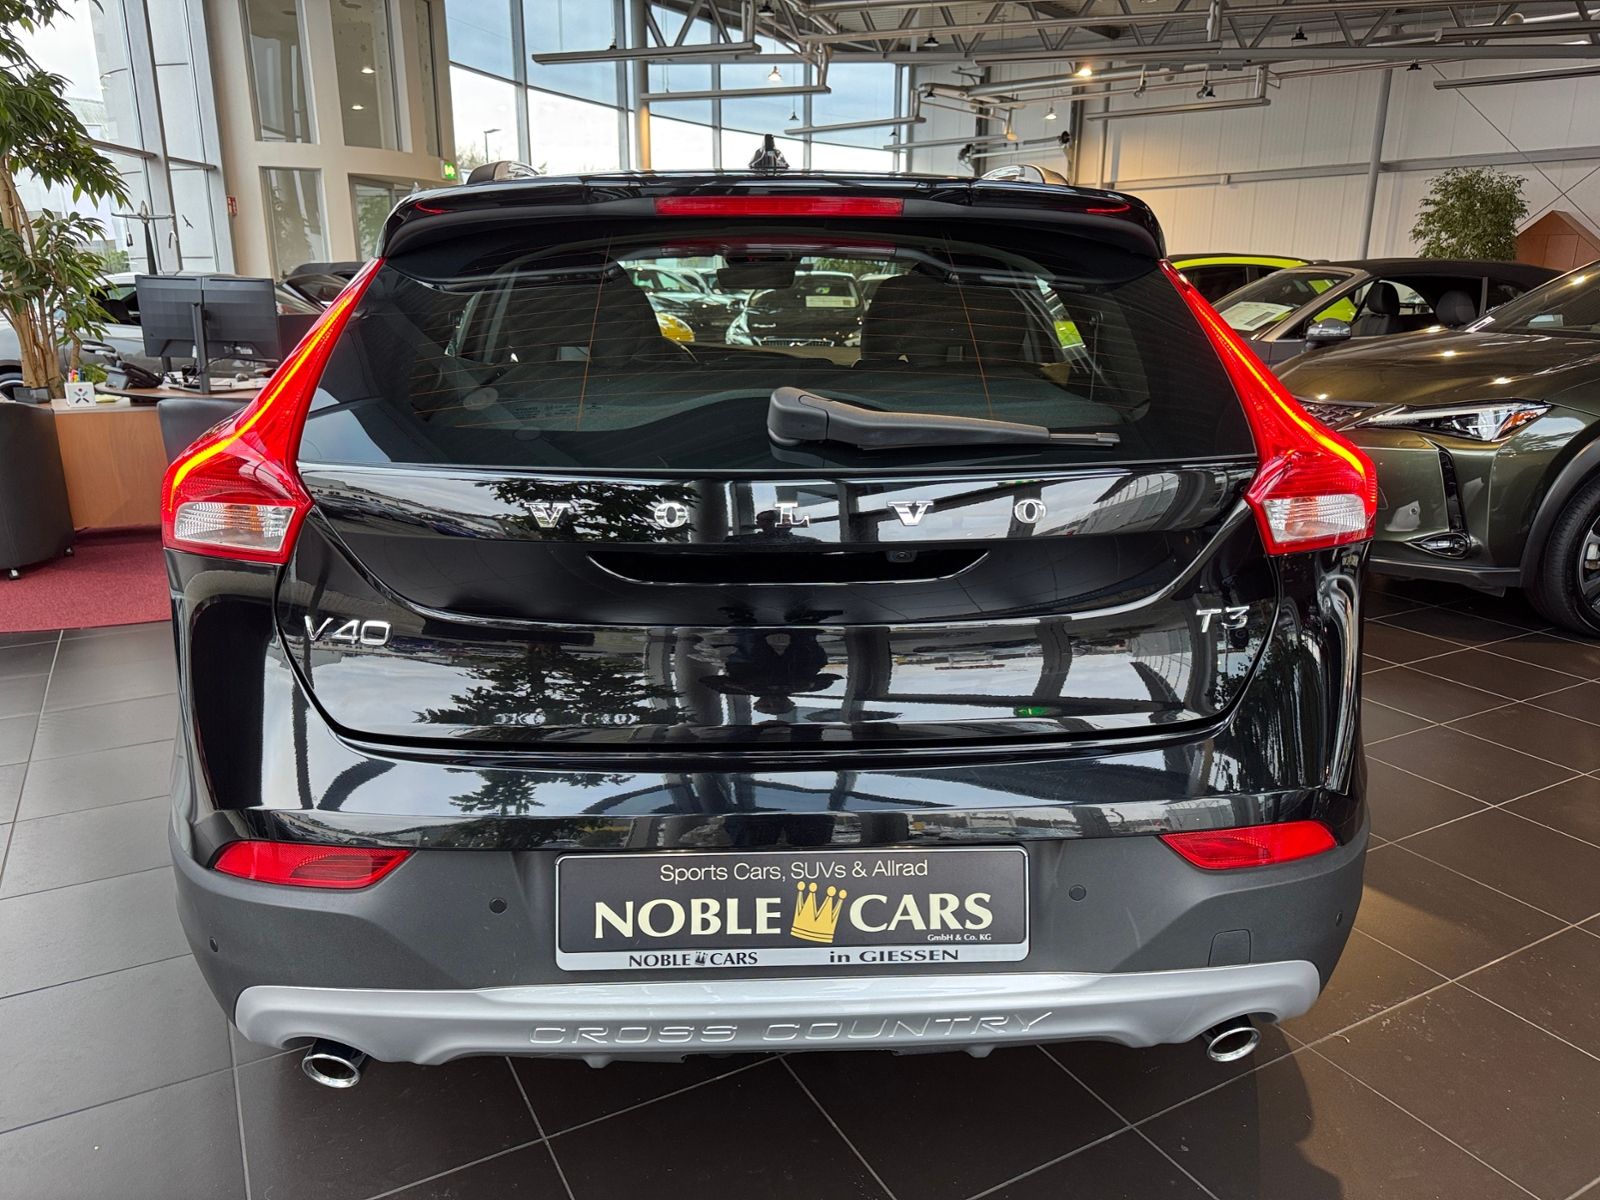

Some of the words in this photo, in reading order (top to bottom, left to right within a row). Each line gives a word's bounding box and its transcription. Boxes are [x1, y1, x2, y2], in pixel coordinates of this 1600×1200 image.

[524, 499, 1047, 529] VOLVO
[304, 615, 392, 646] V40
[1195, 605, 1250, 633] T3
[660, 864, 728, 884] Sports
[733, 863, 786, 882] Cars,
[790, 861, 847, 879] SUVs
[851, 860, 868, 877] &
[872, 860, 928, 876] Allrad
[595, 898, 781, 939] NOBLE
[850, 892, 993, 932] CARS
[927, 934, 954, 942] GmbH
[963, 933, 978, 941] Co.
[979, 933, 992, 941] KG
[629, 954, 691, 967] NOBLE
[710, 952, 758, 966] CARS
[830, 951, 850, 963] in
[859, 949, 959, 962] GIESSEN
[529, 1025, 738, 1045] CROSS
[762, 1011, 1053, 1042] COUNTRY
